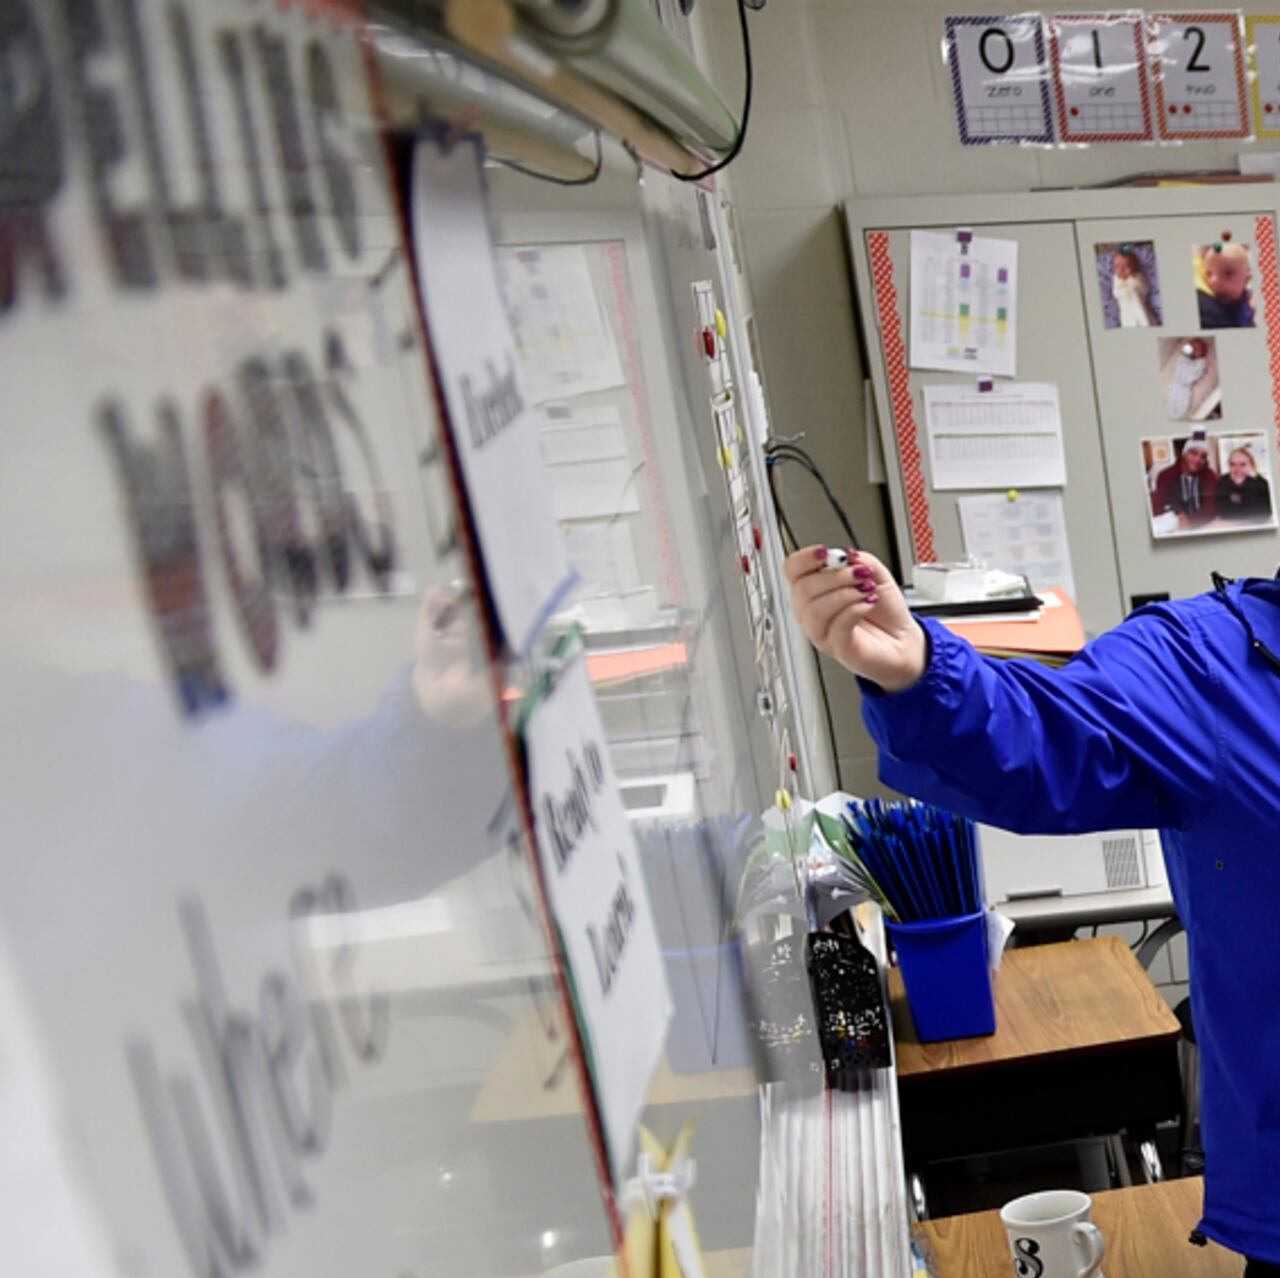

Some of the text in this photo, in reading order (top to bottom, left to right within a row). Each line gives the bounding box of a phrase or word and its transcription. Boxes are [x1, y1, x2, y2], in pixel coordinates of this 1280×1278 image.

[979, 28, 1014, 73] 0
[1092, 29, 1101, 69] 1
[1185, 28, 1211, 72] 2
[986, 85, 1021, 97] zero
[1090, 86, 1115, 97] one
[1186, 84, 1216, 96] two
